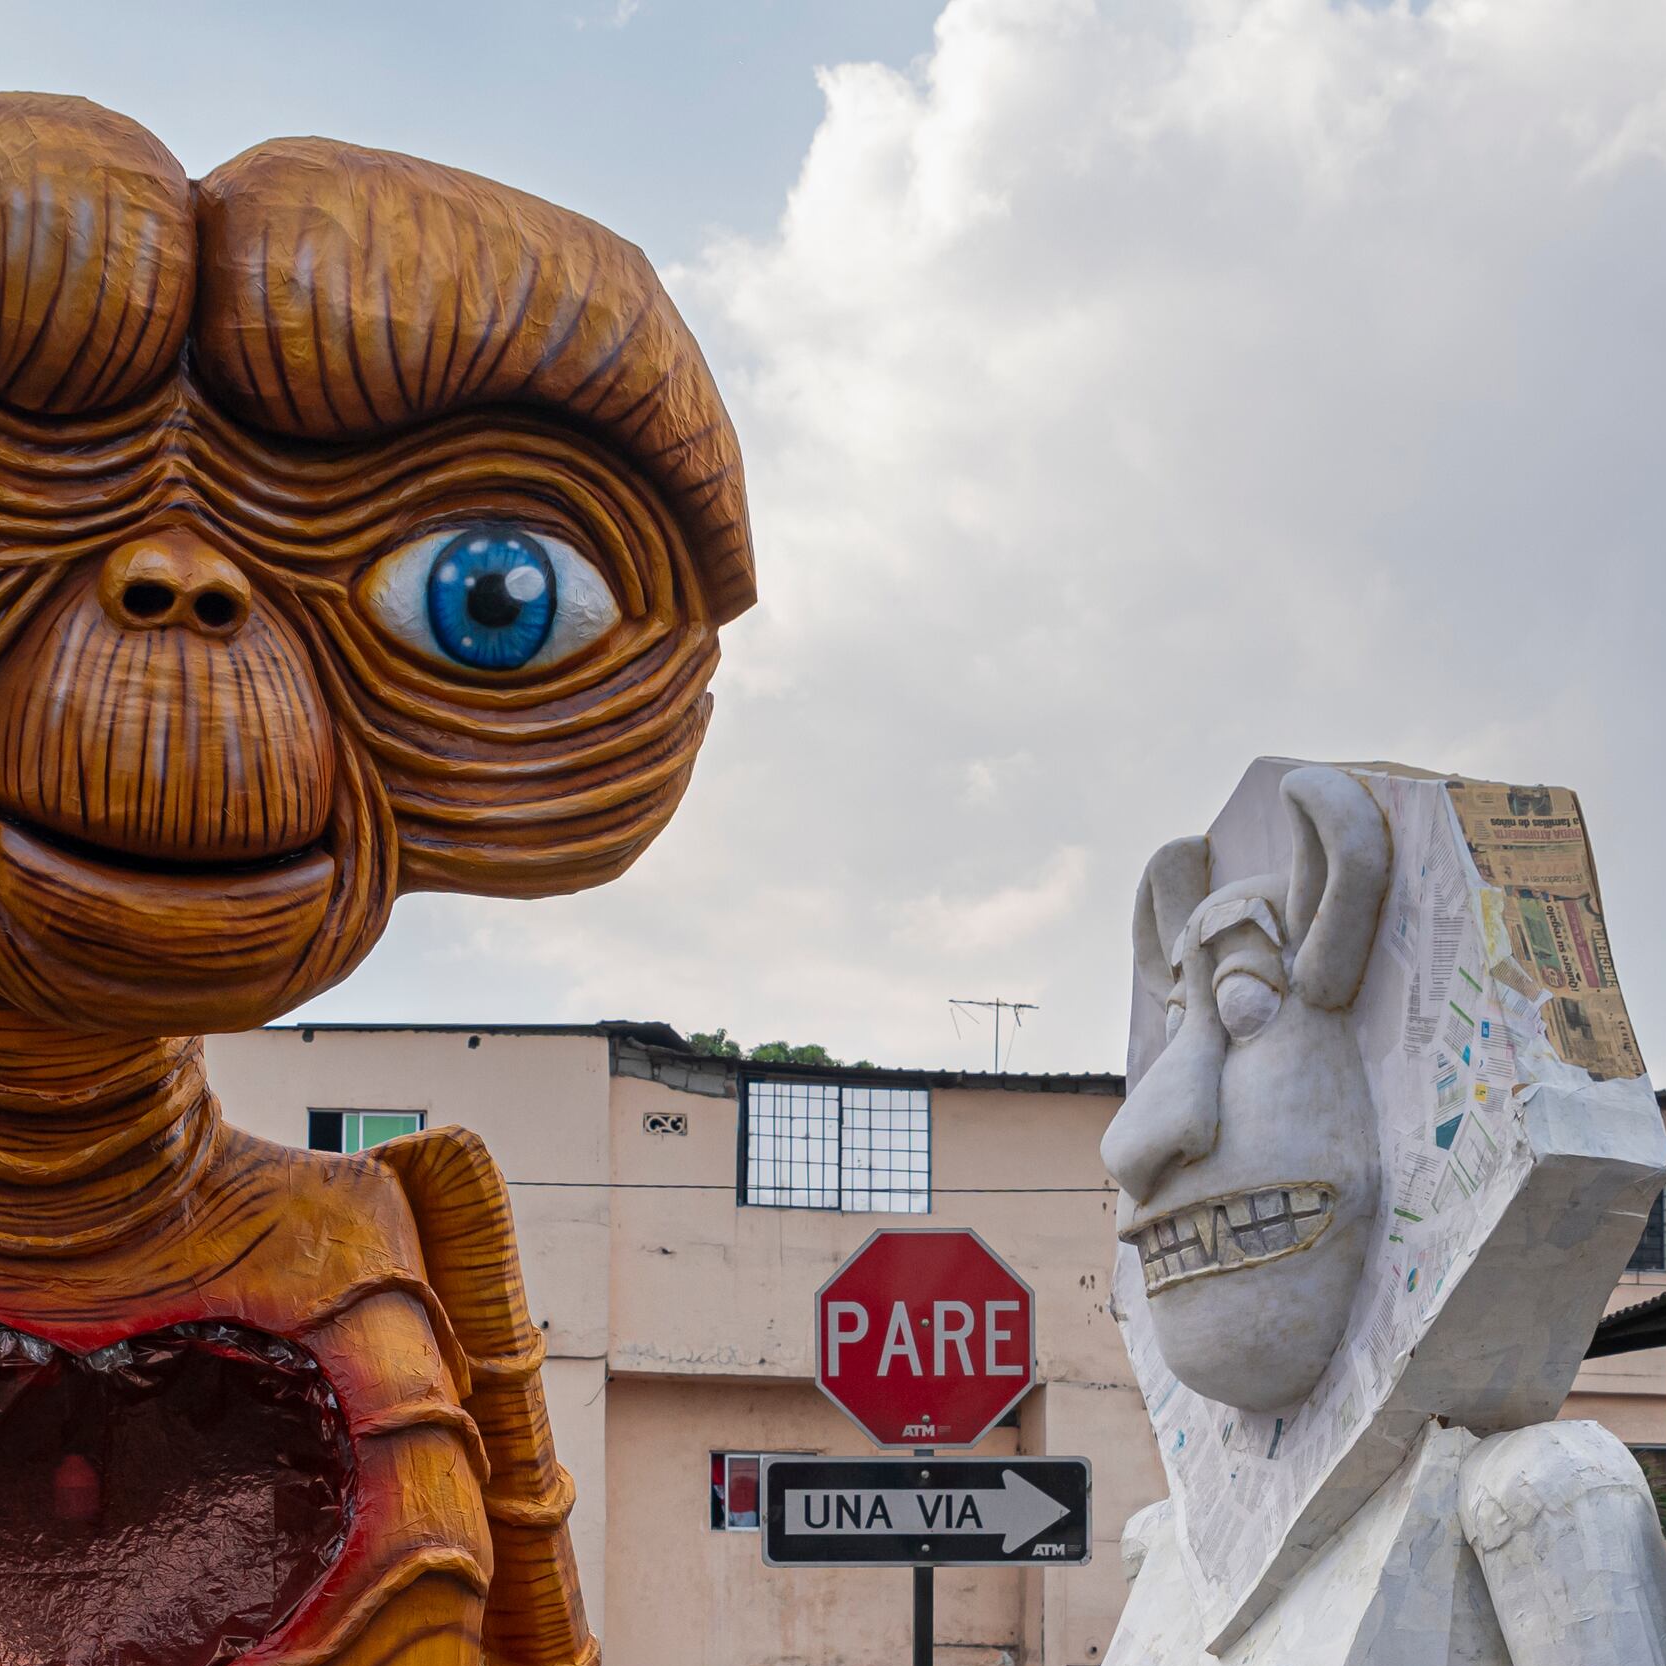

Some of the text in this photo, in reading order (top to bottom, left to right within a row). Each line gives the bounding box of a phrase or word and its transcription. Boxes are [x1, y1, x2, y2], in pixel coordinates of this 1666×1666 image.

[1519, 818, 1530, 828] de
[1532, 818, 1570, 828] familias
[1546, 905, 1563, 939] regalo
[1556, 941, 1566, 953] su
[827, 1300, 1024, 1377] PARE
[901, 1424, 935, 1437] ATM
[804, 1494, 983, 1529] UNA VIA
[1031, 1543, 1066, 1556] ATM
